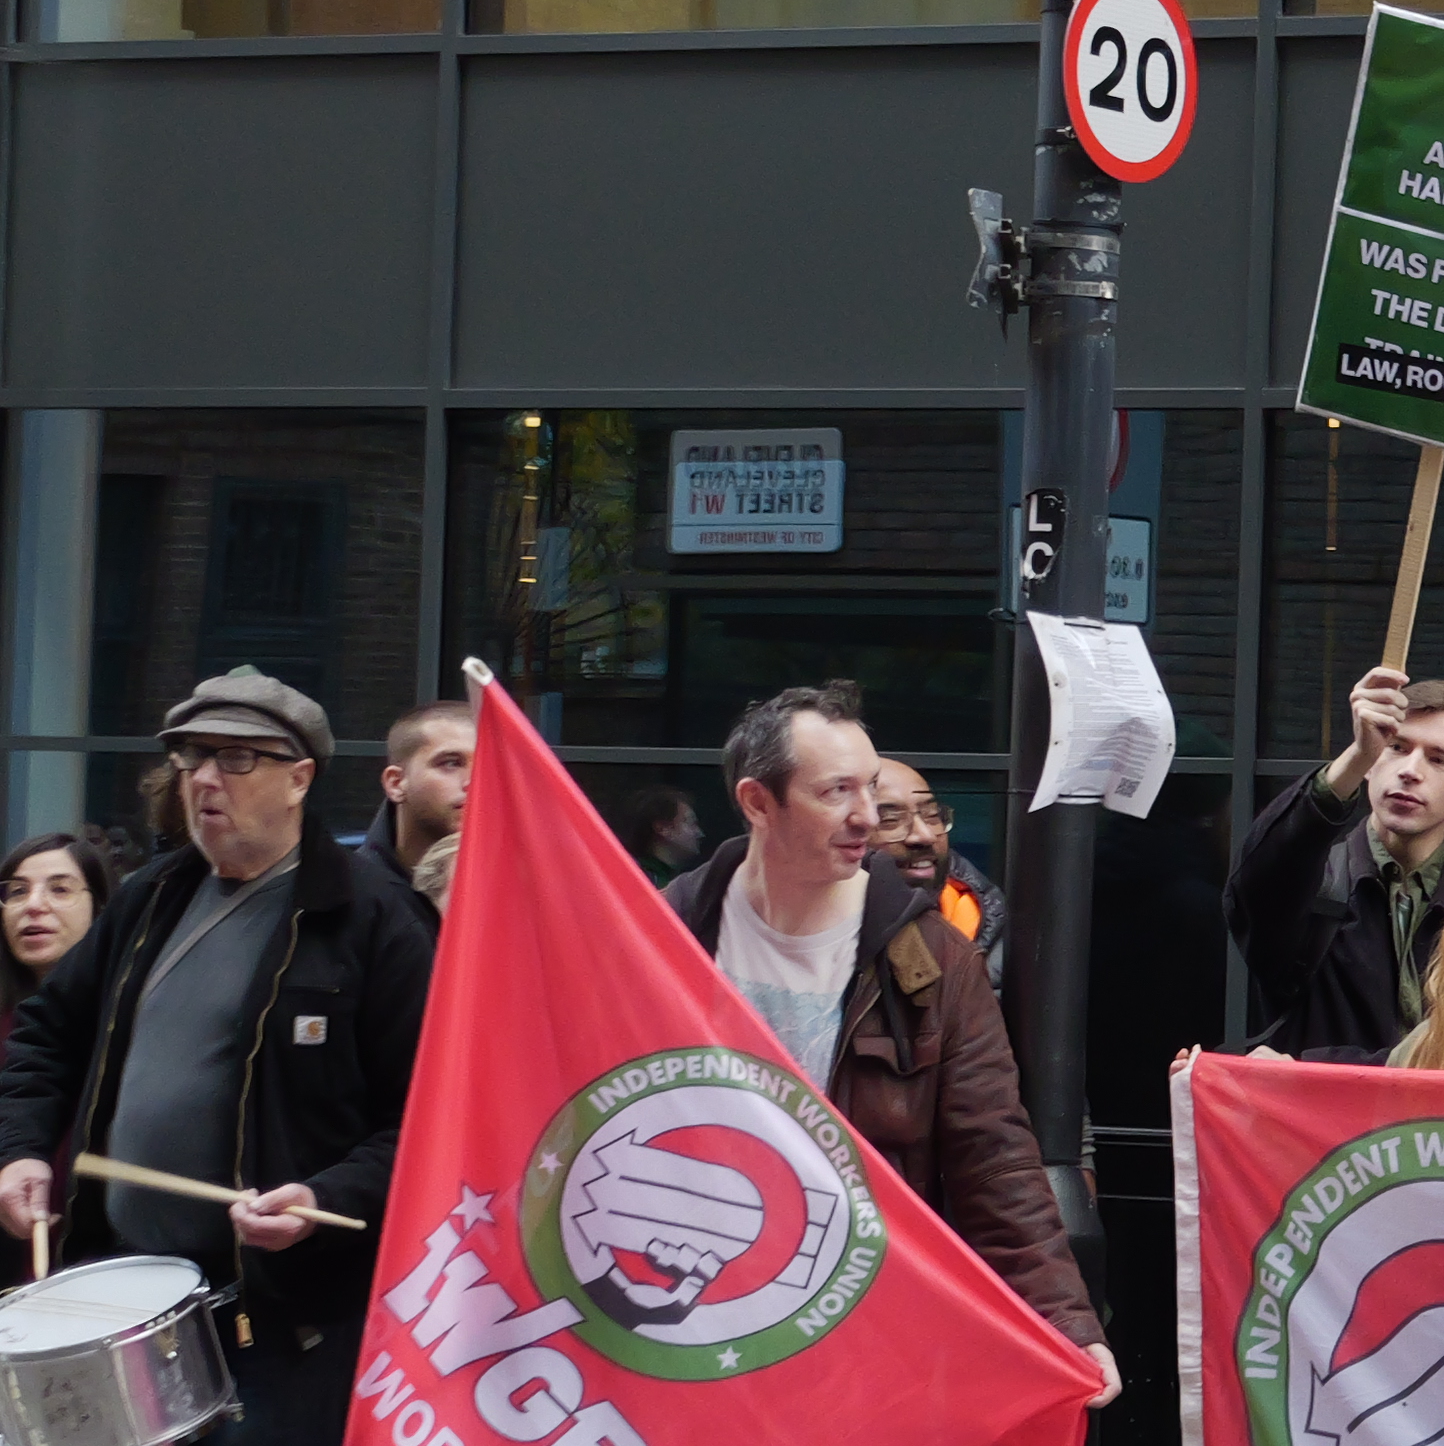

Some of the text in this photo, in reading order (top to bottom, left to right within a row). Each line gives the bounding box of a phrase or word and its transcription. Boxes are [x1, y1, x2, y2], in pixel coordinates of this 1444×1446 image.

[1088, 25, 1178, 123] 20
[1360, 239, 1428, 279] WAS
[1371, 289, 1432, 328] THE
[1341, 353, 1403, 389] LAW,
[587, 1054, 882, 1337] INDEPENDENT WORKERS UNION
[1244, 1137, 1402, 1380] INDEPENDENT
